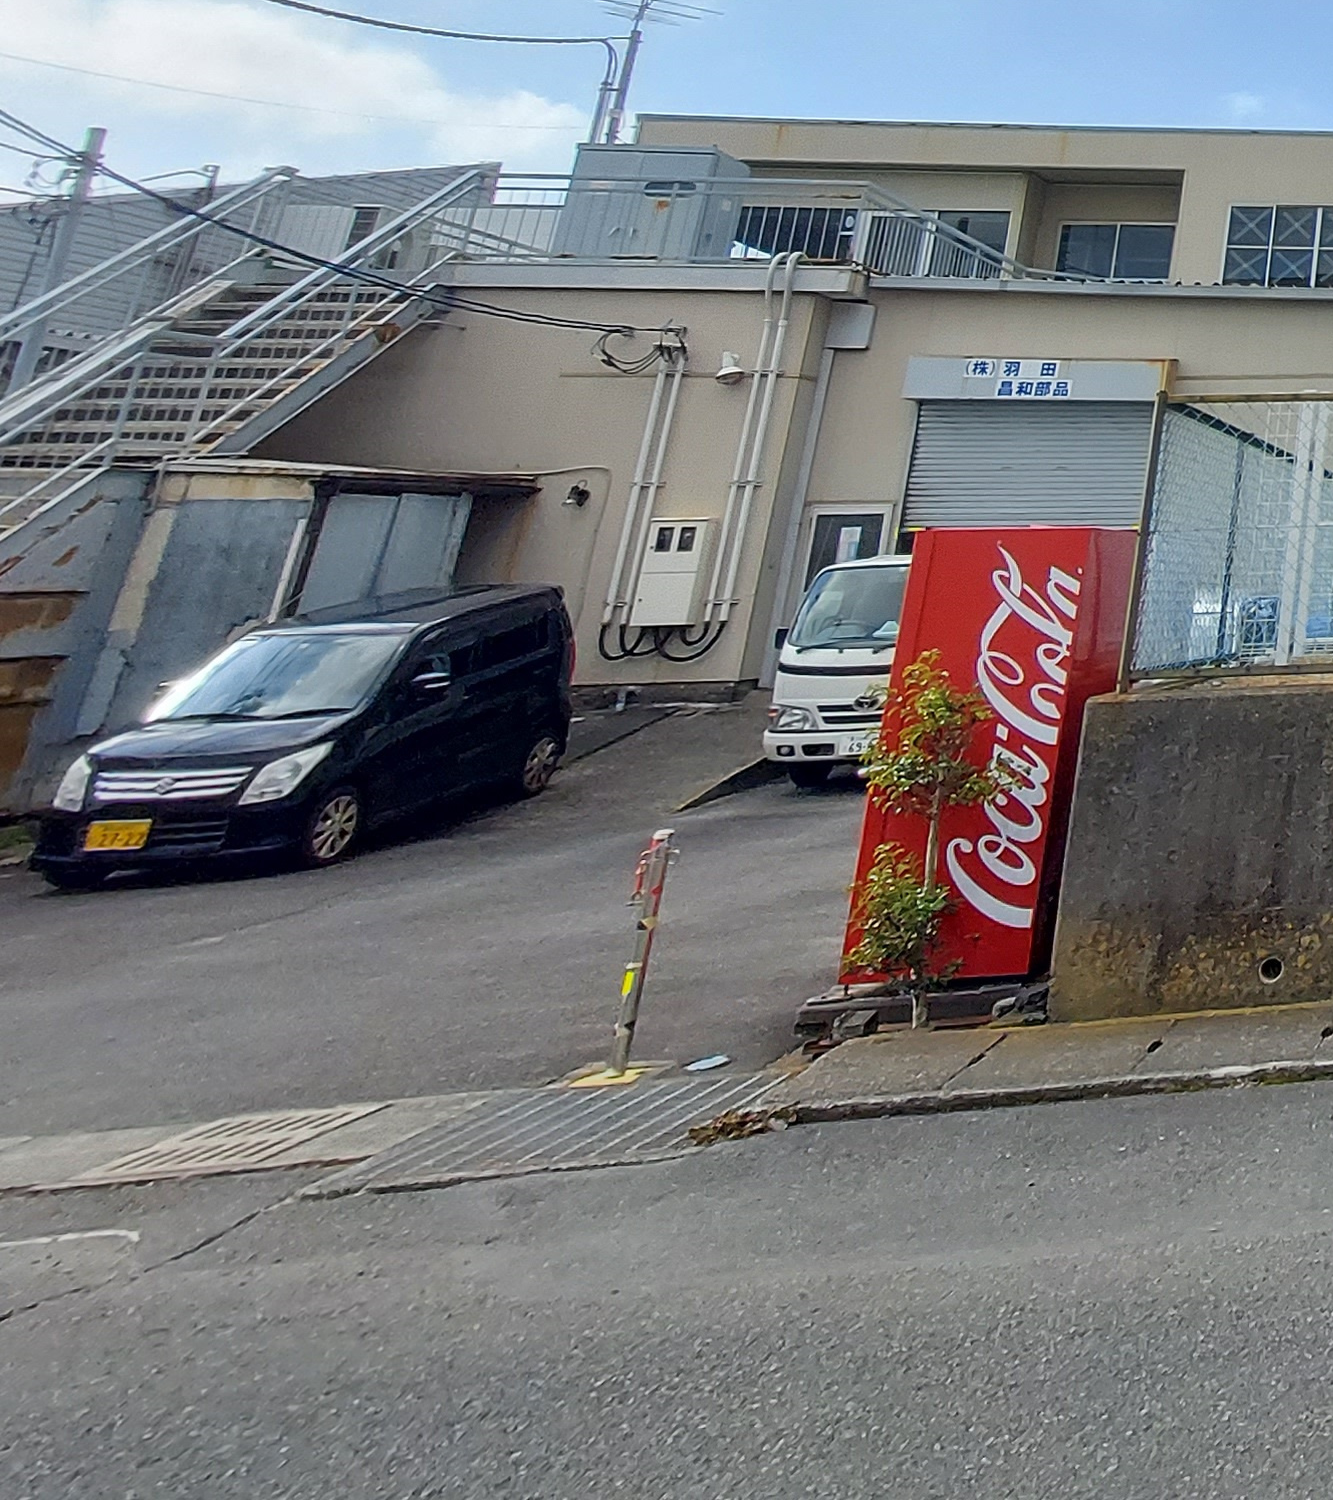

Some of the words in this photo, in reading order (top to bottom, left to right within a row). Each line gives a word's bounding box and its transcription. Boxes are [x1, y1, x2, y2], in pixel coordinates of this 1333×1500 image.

[997, 381, 1069, 397] 昌和部品
[947, 540, 1081, 928] Coca-Cola
